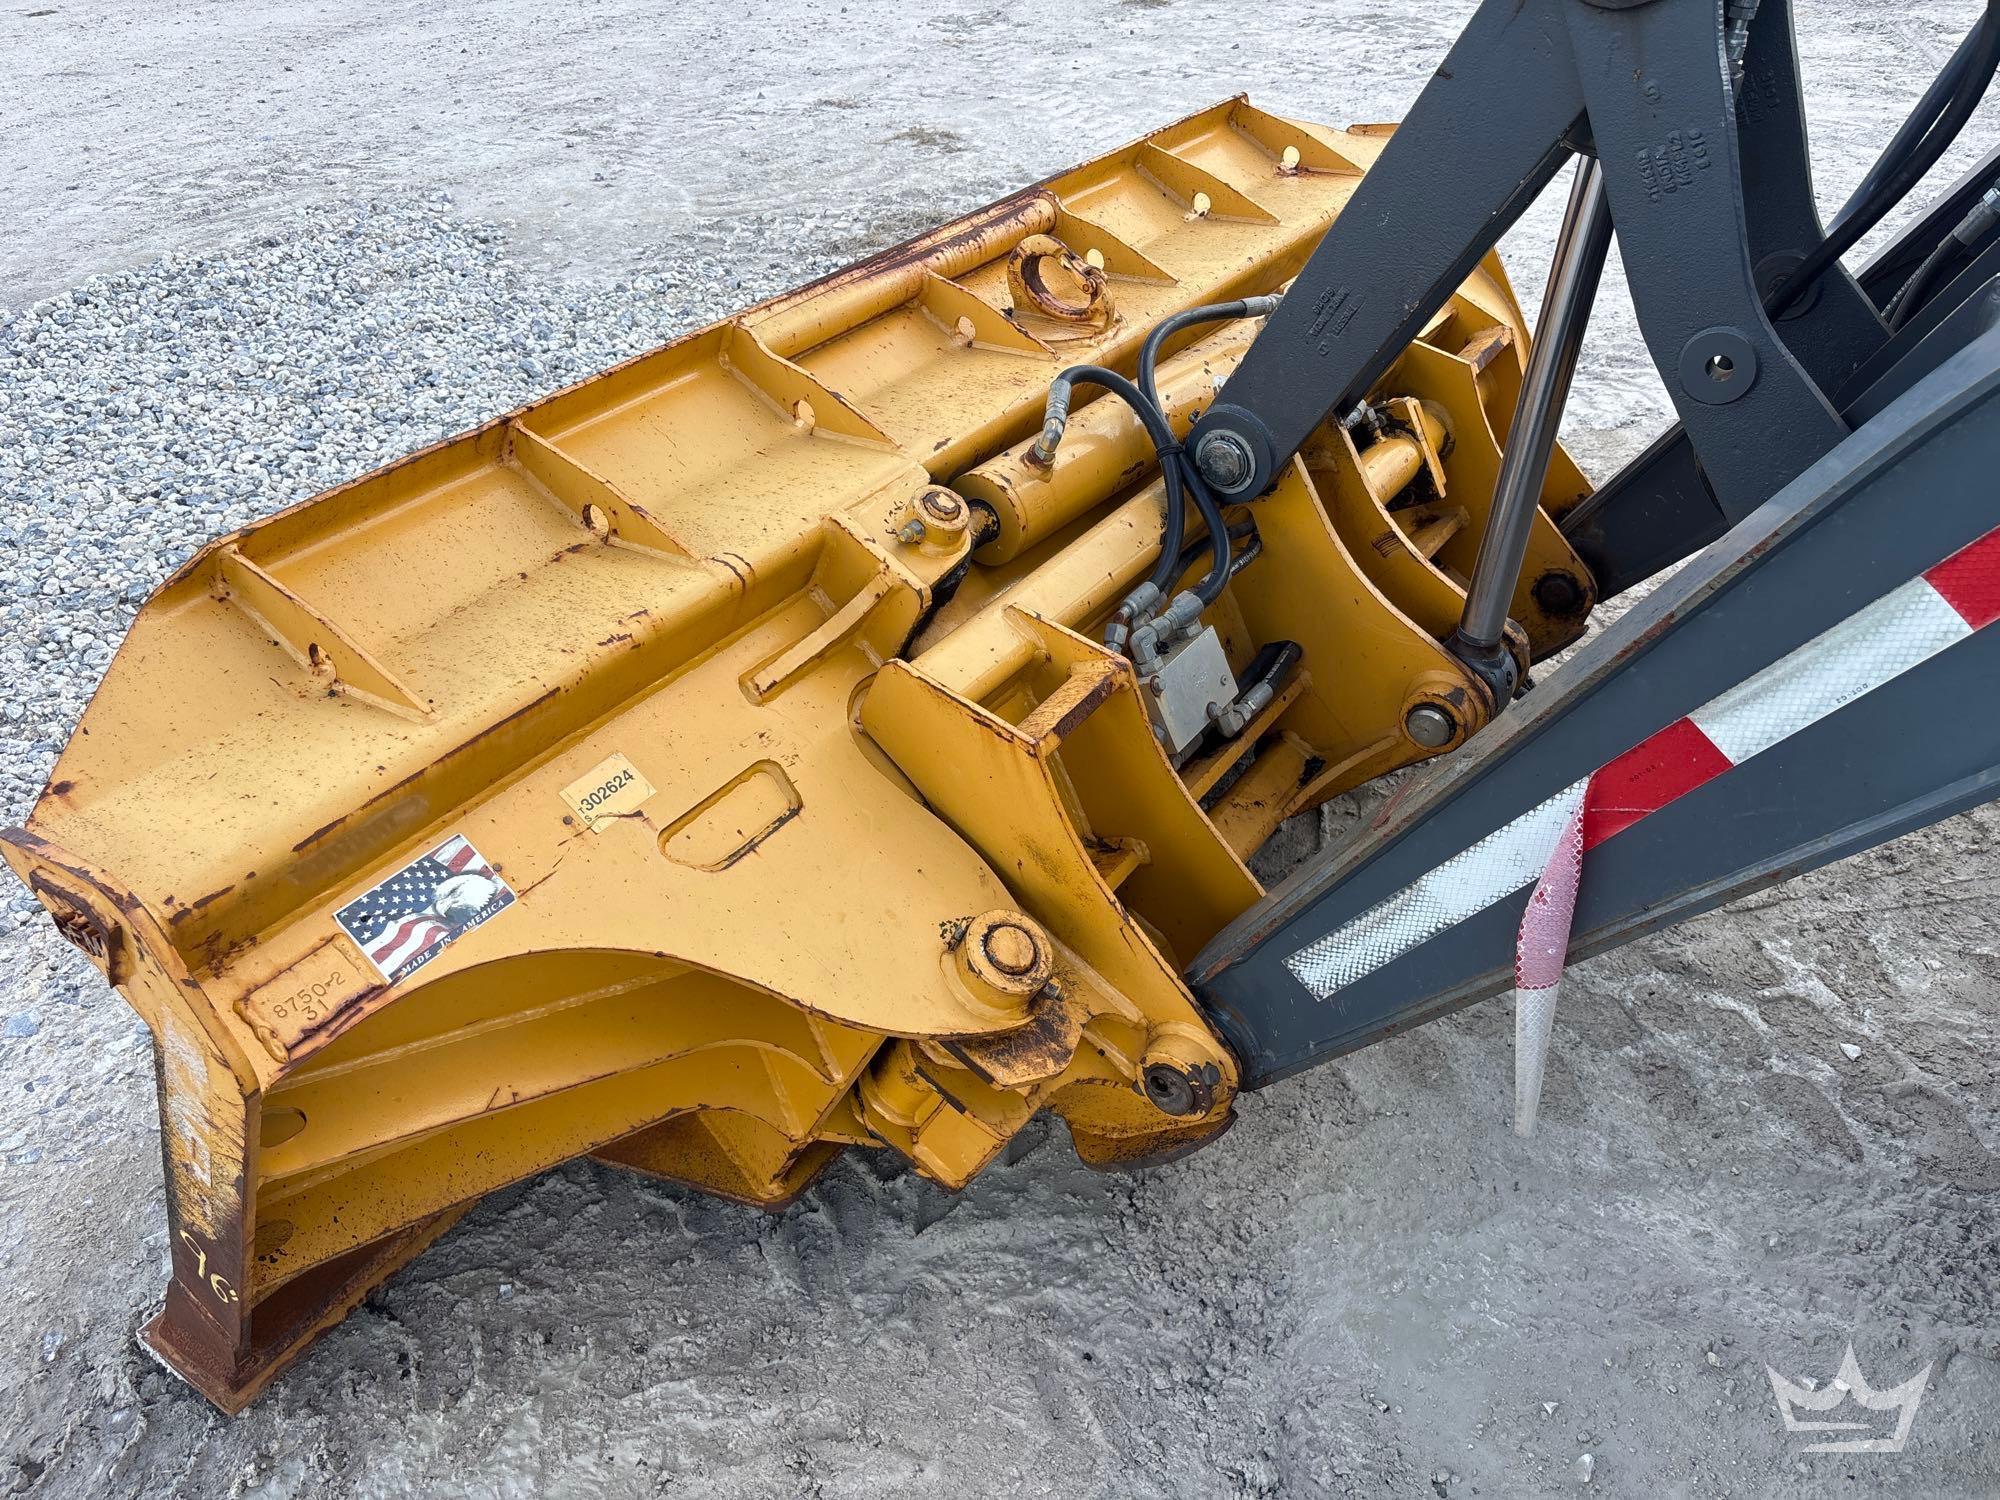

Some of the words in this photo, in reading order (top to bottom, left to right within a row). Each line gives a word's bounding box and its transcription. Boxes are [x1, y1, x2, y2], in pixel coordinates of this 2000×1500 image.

[580, 769, 635, 812] 302624
[584, 815, 593, 823] S
[401, 951, 432, 974] MADE
[439, 935, 452, 949] IN
[460, 899, 506, 935] AMERICA
[273, 971, 346, 1019] 8750-2
[301, 999, 329, 1022] 31
